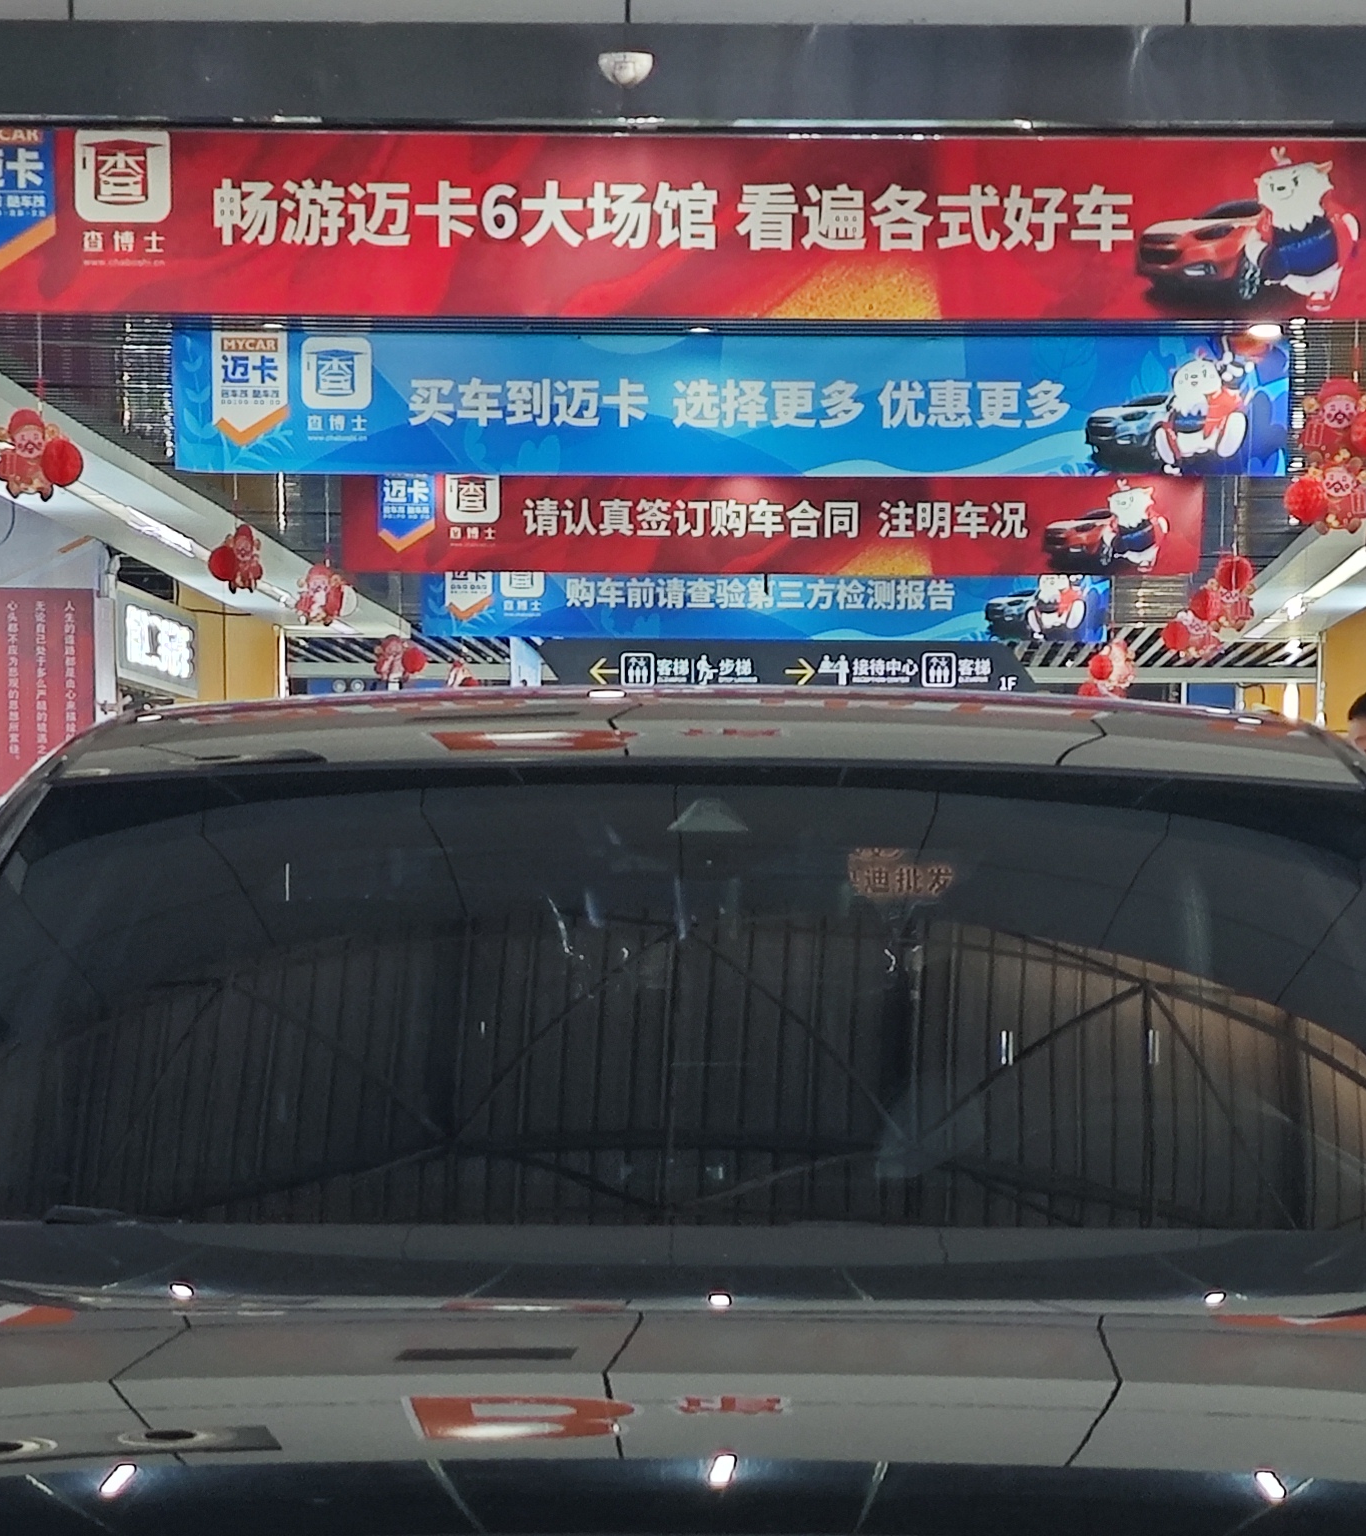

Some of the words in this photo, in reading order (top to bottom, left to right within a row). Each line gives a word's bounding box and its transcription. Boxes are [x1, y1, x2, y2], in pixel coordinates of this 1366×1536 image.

[213, 178, 718, 250] 畅游迈卡6大场馆
[737, 183, 1135, 252] 看遍各式好车
[83, 231, 165, 253] 查博士
[223, 339, 276, 350] MYCAR
[221, 355, 278, 384] 迈卡
[408, 378, 651, 428] 买车到迈卡
[673, 379, 863, 429] 选择更多
[878, 379, 1071, 429] 优惠更多
[307, 415, 368, 432] 查博士
[383, 480, 430, 503] 迈卡
[523, 499, 859, 538] 请认真签订购车合同
[878, 501, 1028, 539] 注明车况
[566, 580, 955, 611] 购车前请查验第三方检测报告
[657, 658, 688, 675] 客梯
[719, 658, 751, 675] 步梯
[853, 659, 918, 676] 接待中心
[958, 659, 991, 675] 客梯
[999, 677, 1017, 691] 1F
